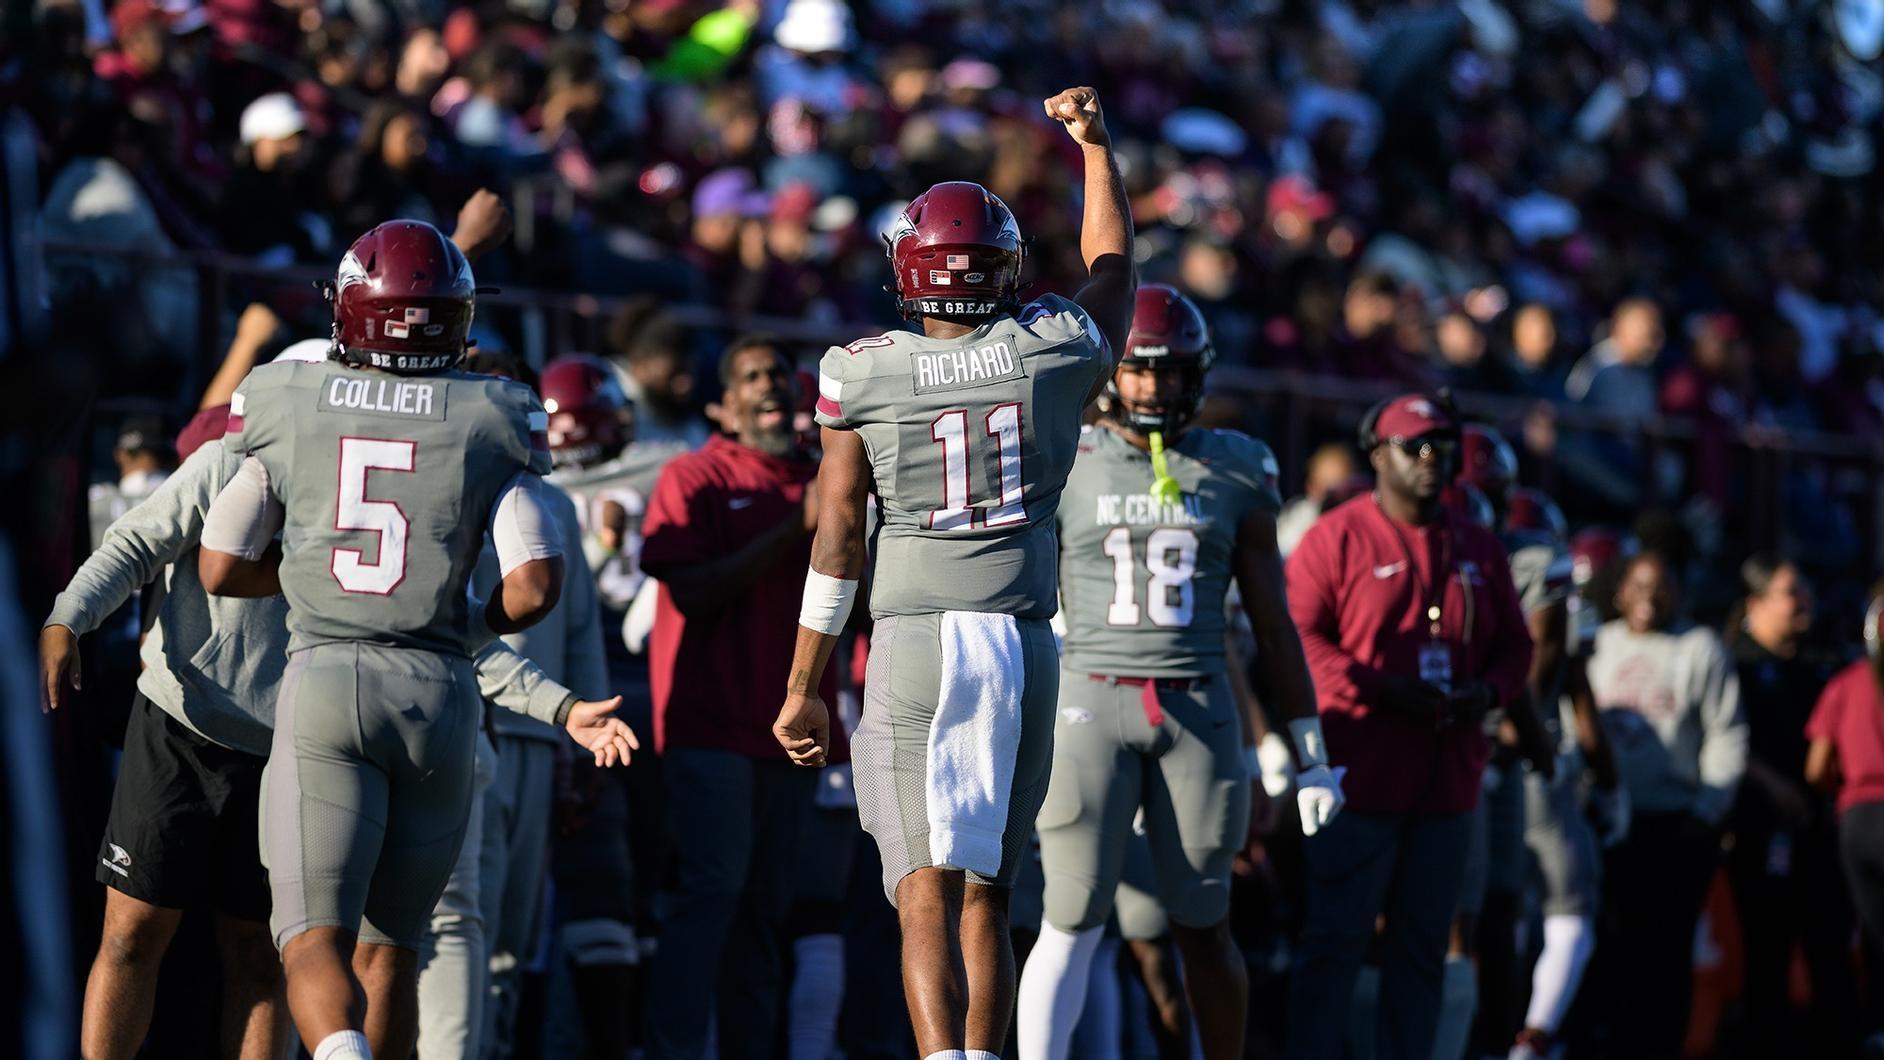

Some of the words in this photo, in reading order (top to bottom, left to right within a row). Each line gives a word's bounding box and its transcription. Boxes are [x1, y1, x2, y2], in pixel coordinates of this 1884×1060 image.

[921, 301, 939, 313] BE
[945, 302, 995, 314] GREAT
[370, 352, 391, 367] BE
[397, 355, 450, 368] GREAT
[917, 341, 1016, 388] RICHARD
[328, 376, 434, 416] COLLIER
[928, 401, 1029, 531] 11
[330, 433, 419, 598] 5
[1096, 494, 1122, 526] NC
[1125, 493, 1214, 525] CENTRAL
[1103, 526, 1200, 628] 18
